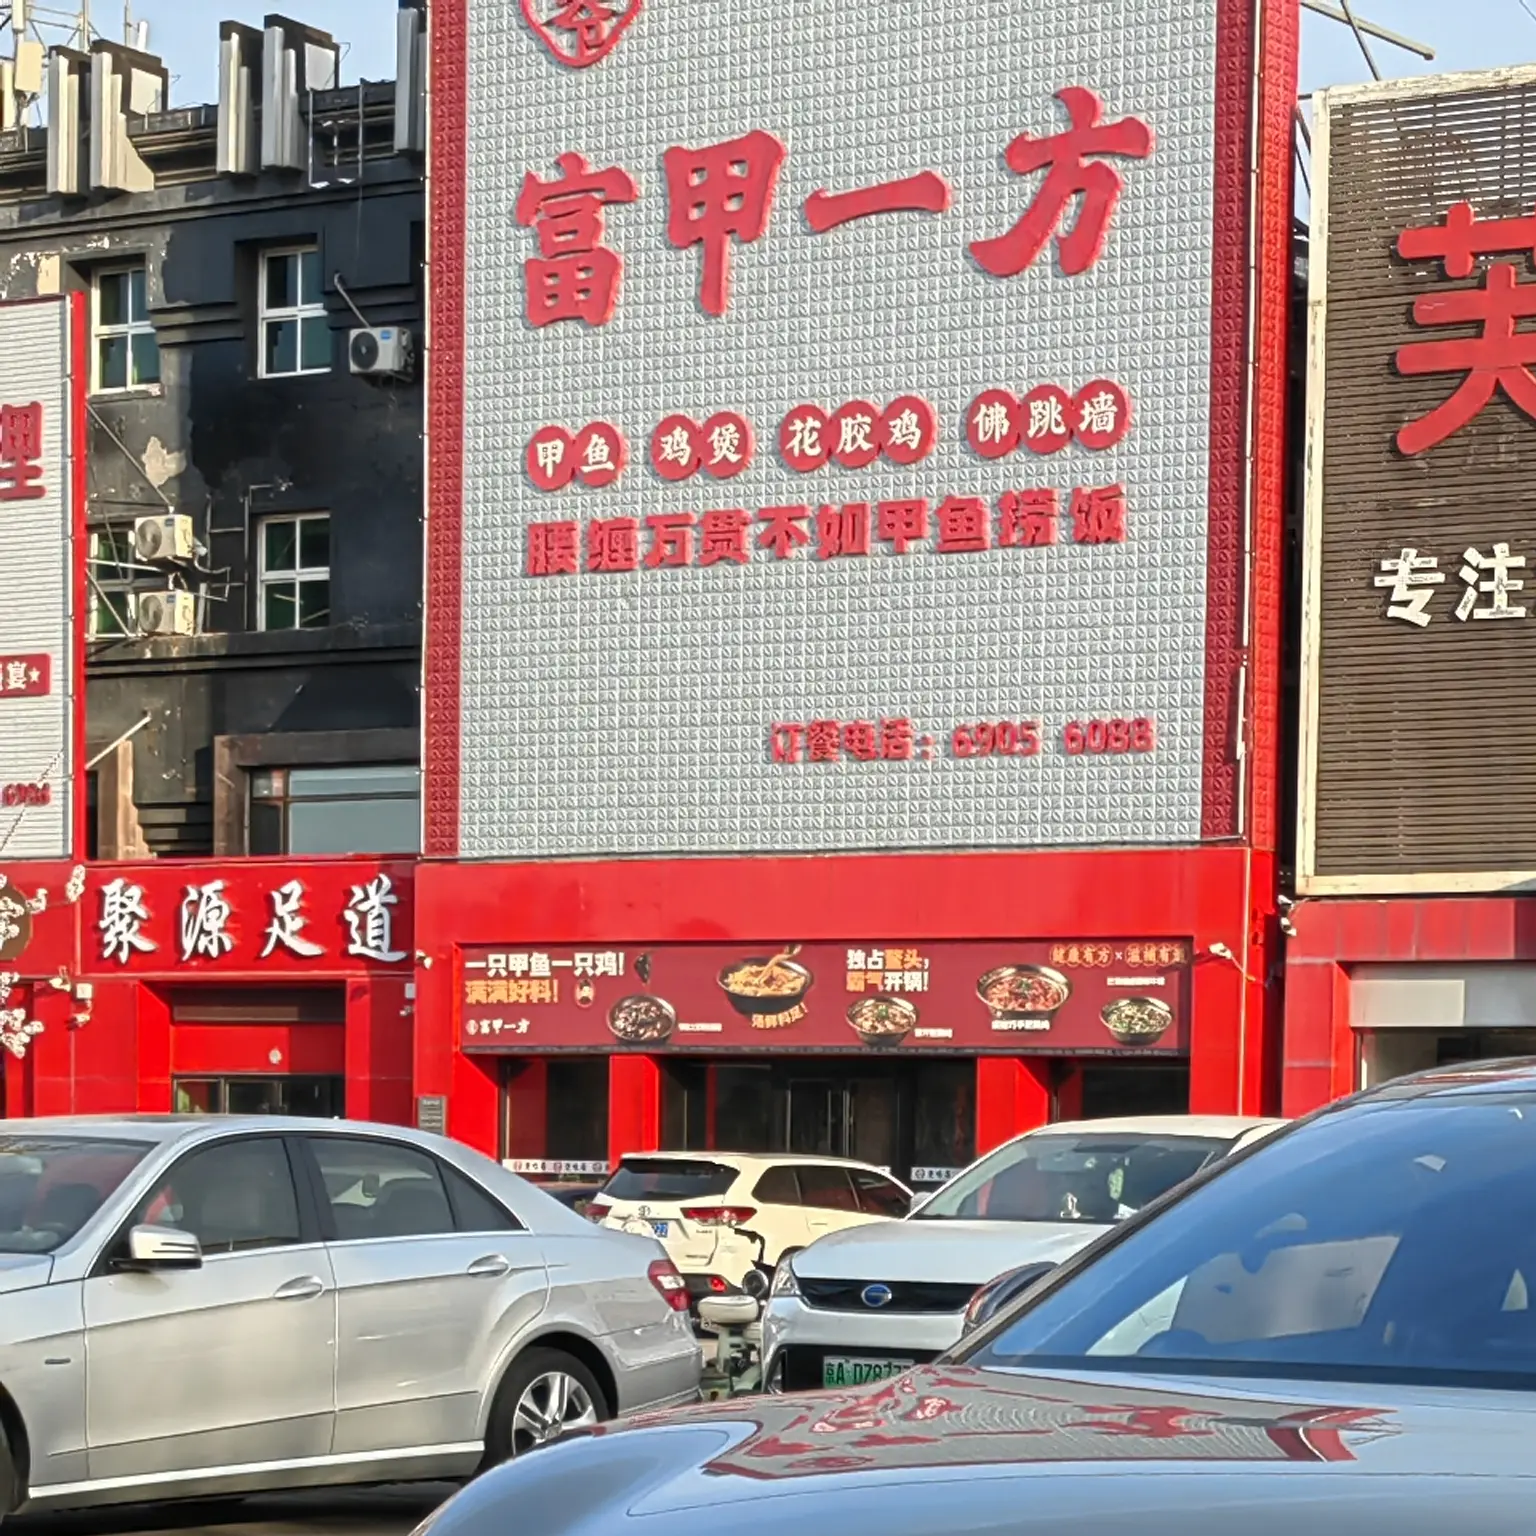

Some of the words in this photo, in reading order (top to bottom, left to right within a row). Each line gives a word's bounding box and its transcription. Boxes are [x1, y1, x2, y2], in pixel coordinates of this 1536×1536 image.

[514, 85, 1156, 327] 富甲一方
[531, 429, 618, 480] 甲鱼
[655, 419, 745, 468] 鸡煲
[782, 407, 925, 456] 花胶鸡
[970, 389, 1120, 445] 佛跳墙
[525, 483, 1129, 577] 腰缠万贯不如甲鱼捞饭
[98, 872, 409, 965] 聚源足道
